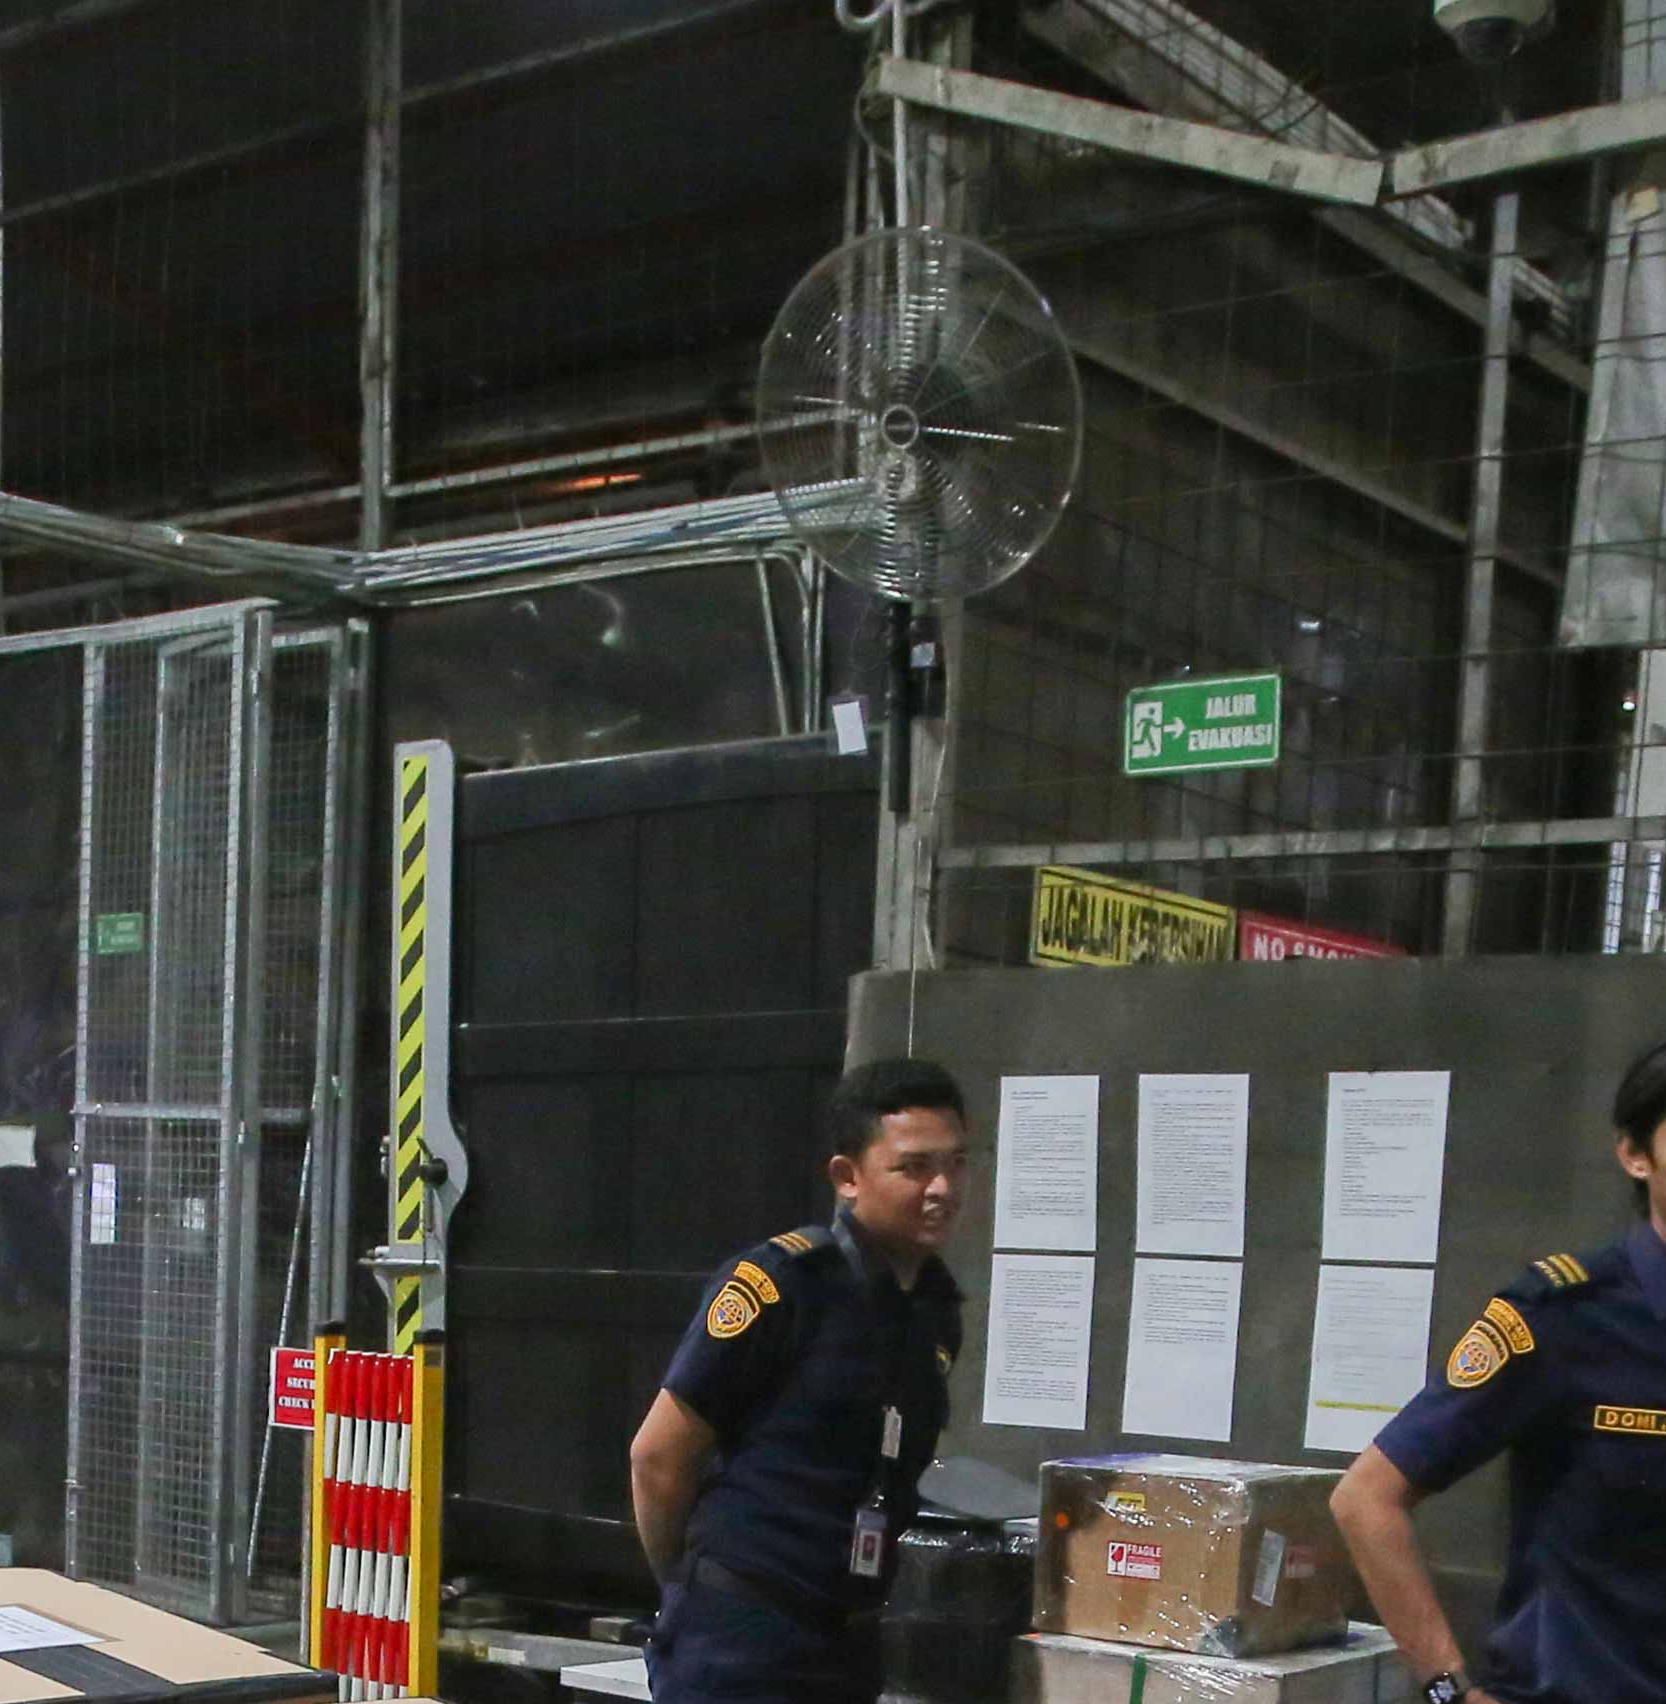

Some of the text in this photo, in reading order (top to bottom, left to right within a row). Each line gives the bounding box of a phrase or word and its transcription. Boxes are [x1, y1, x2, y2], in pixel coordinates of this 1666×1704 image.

[1205, 692, 1256, 719] JALUR
[1188, 721, 1274, 753] EVAKUASI
[1253, 932, 1285, 961] NO
[278, 1395, 310, 1410] CHECK
[1604, 1410, 1657, 1429] DONI
[1127, 1543, 1163, 1558] FRAGILE
